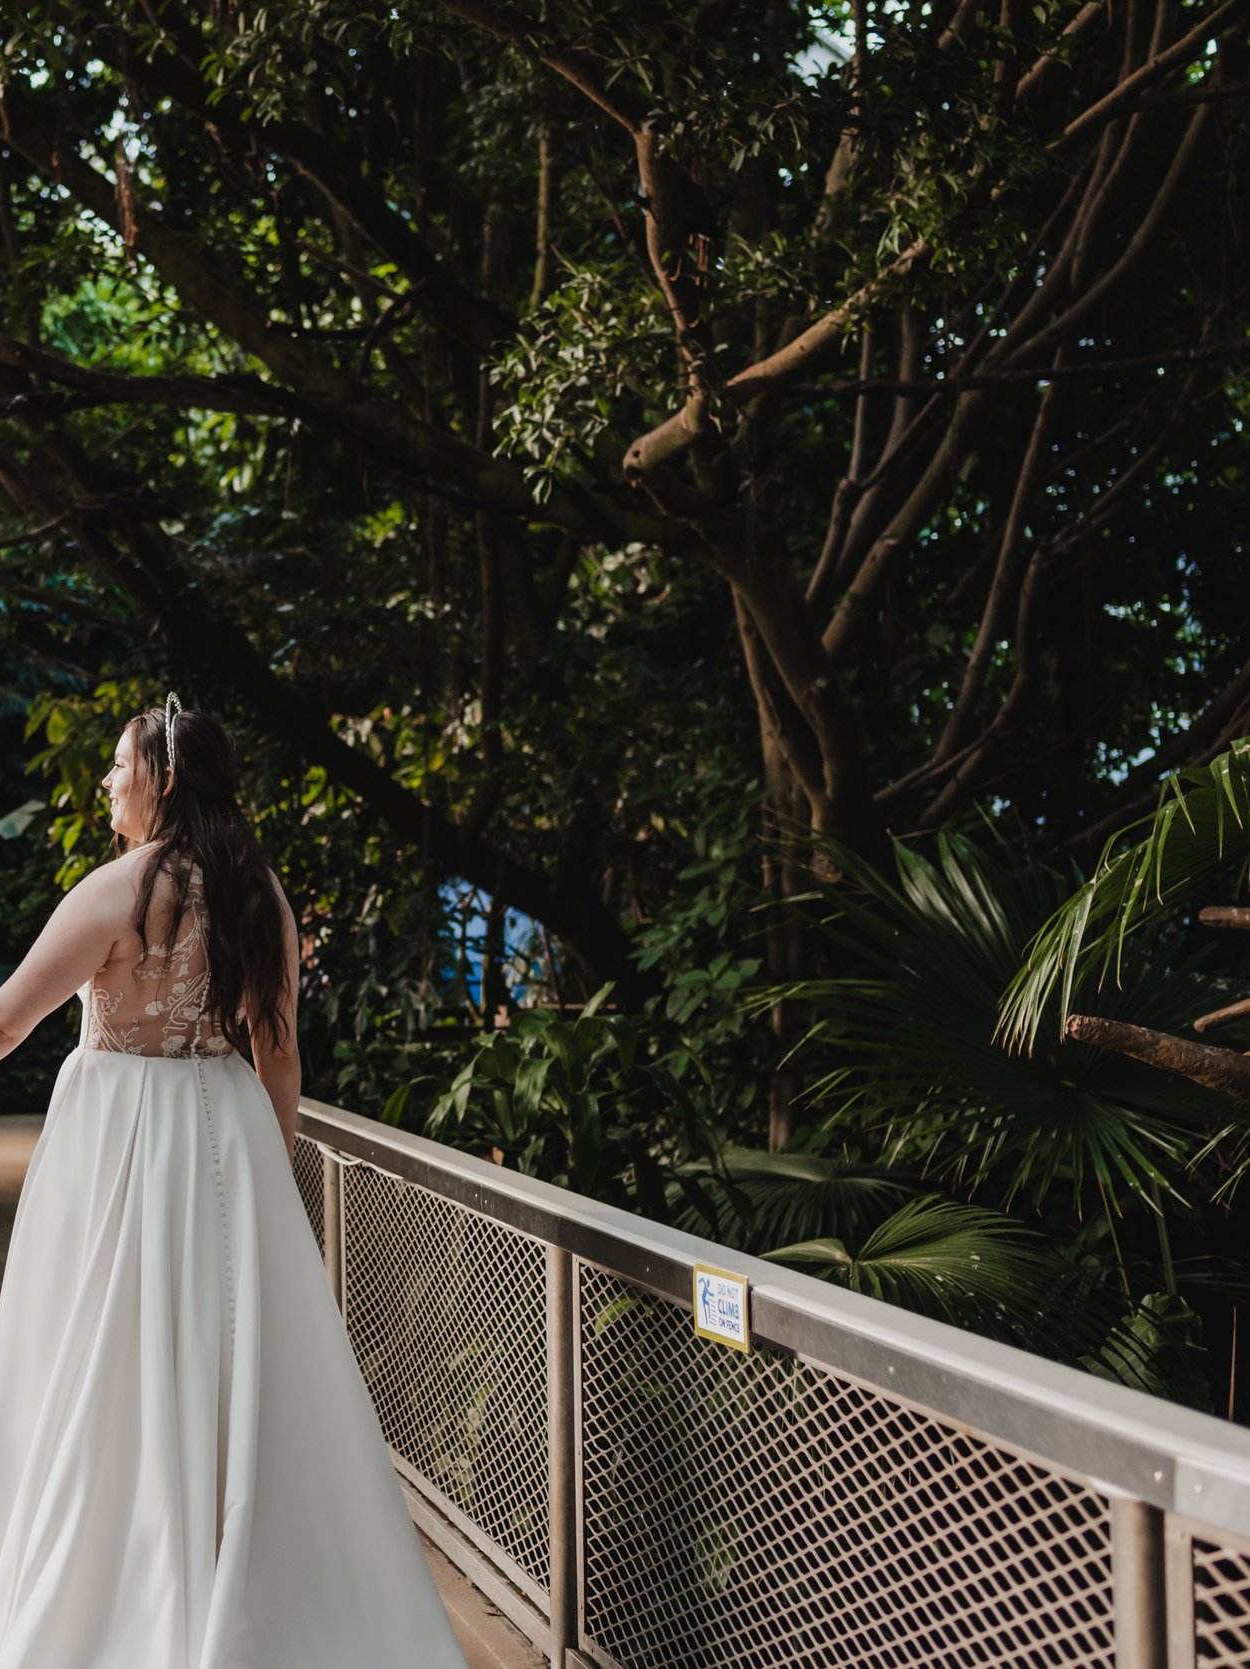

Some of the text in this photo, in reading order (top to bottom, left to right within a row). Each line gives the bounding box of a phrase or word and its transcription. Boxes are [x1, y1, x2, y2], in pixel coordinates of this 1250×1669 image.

[717, 1283, 739, 1300] DO NOT
[717, 1299, 740, 1320] CLIMB
[718, 1317, 740, 1333] ON FENCE
